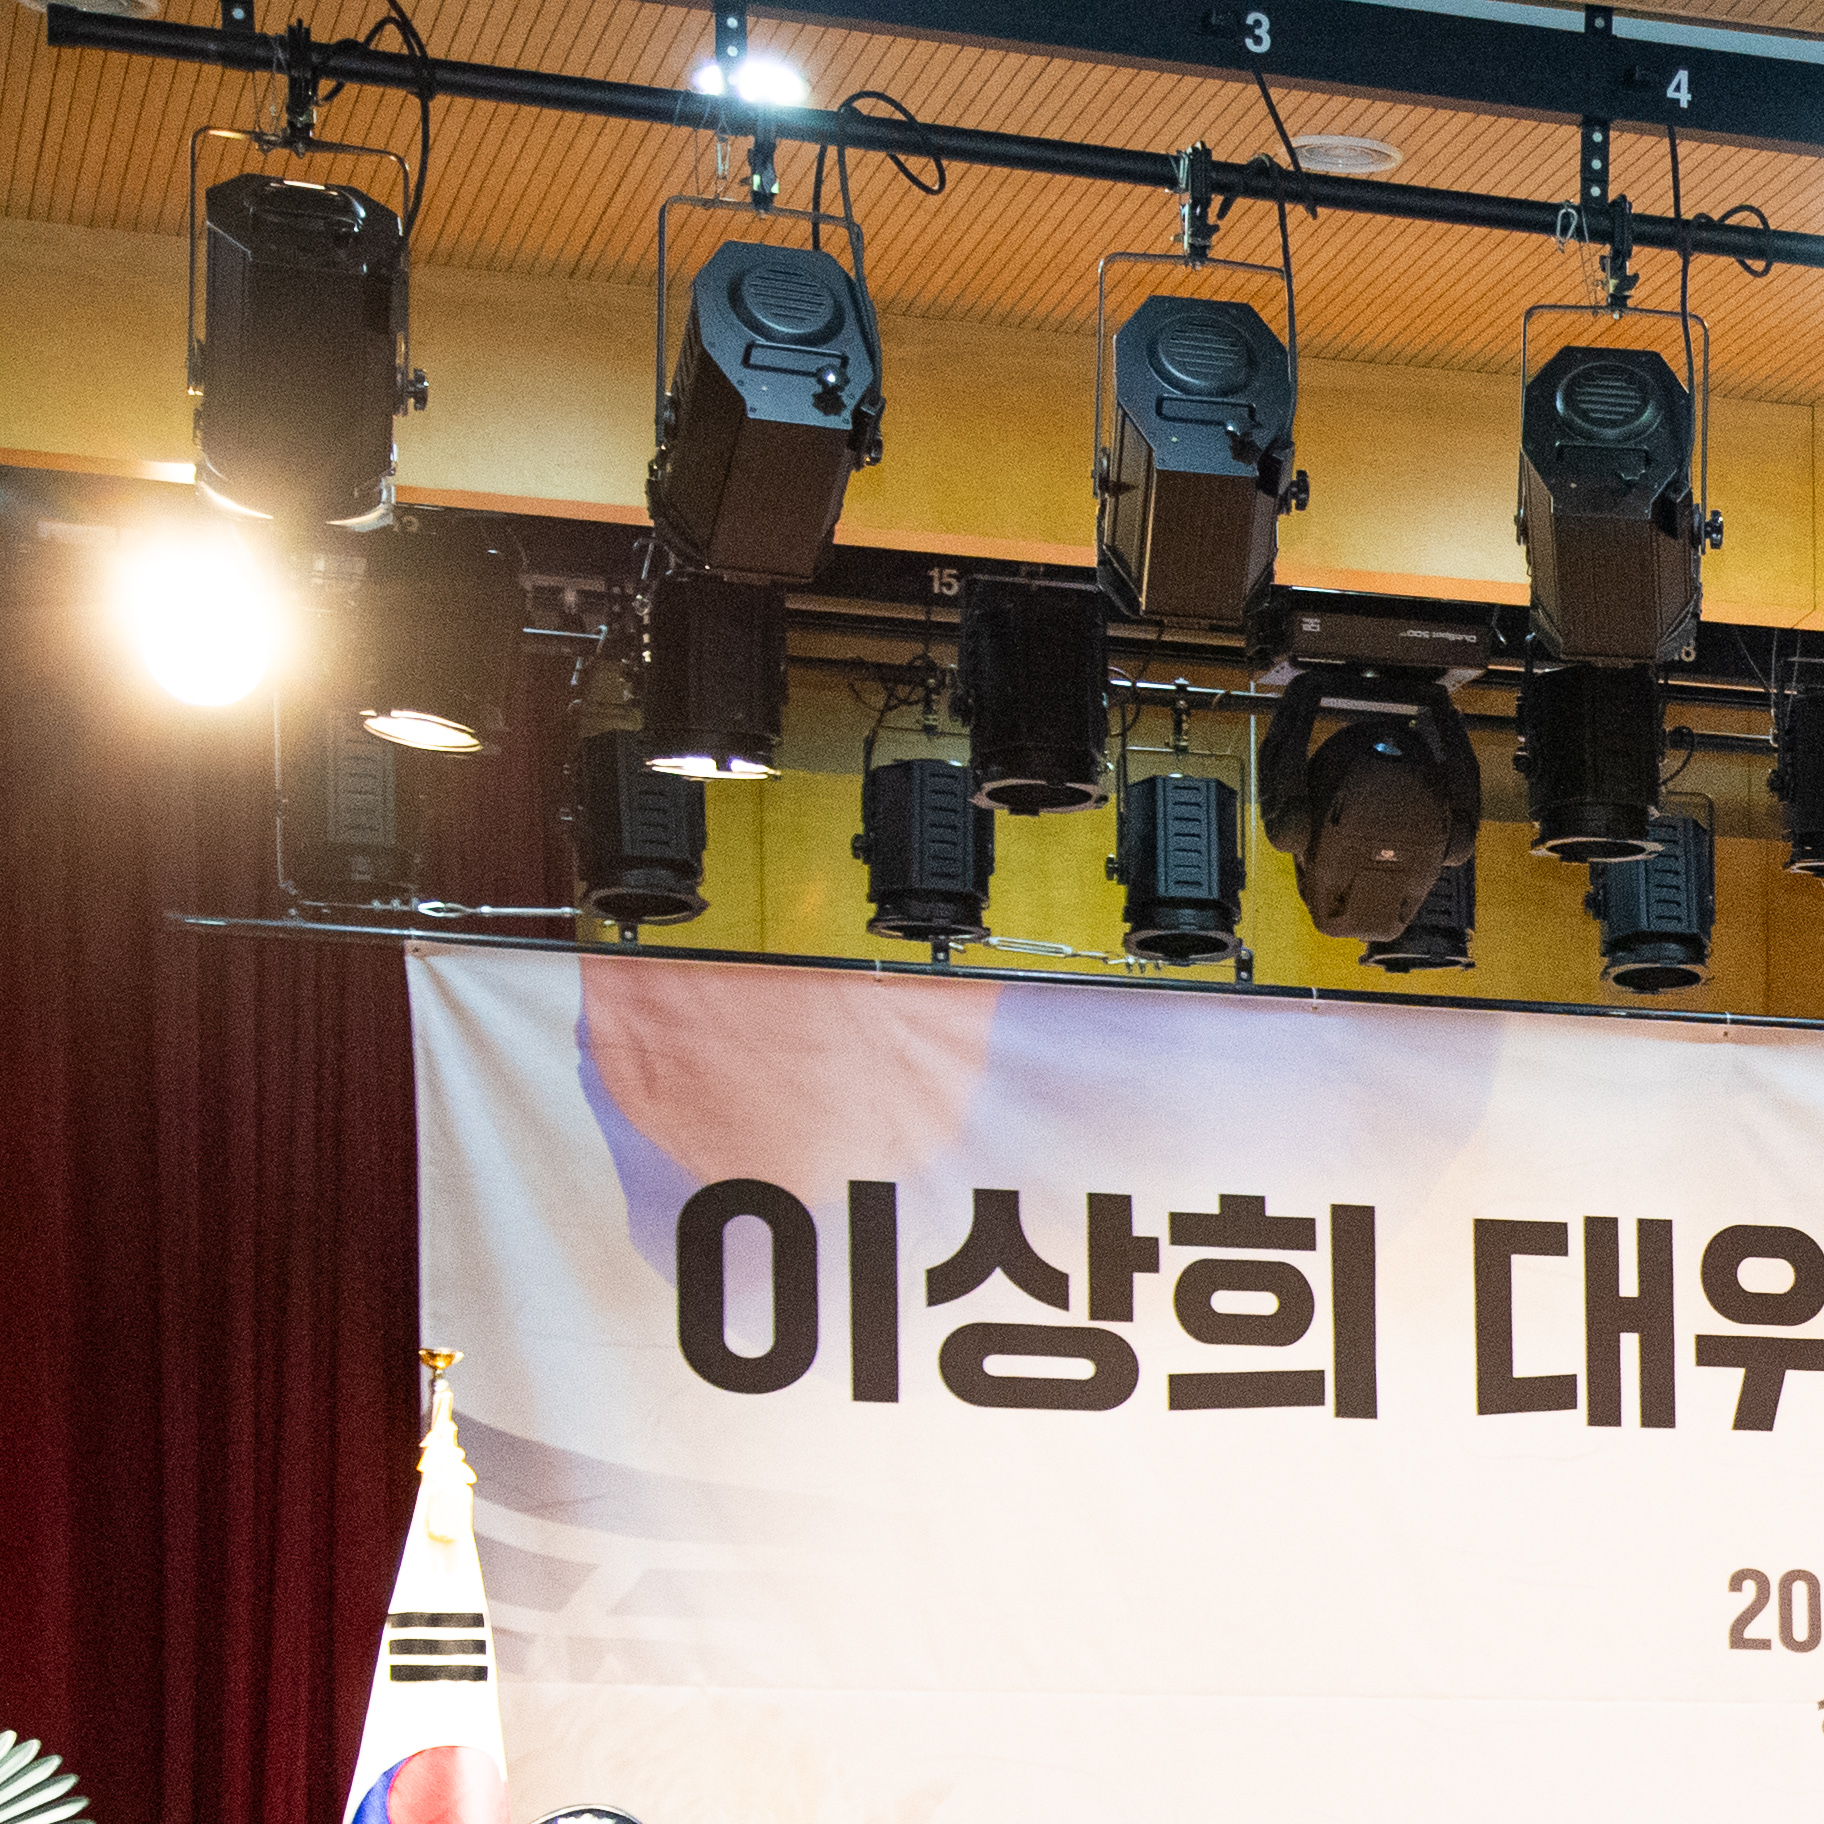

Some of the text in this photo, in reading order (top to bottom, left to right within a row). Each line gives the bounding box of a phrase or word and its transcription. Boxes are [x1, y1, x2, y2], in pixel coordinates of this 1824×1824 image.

[1243, 11, 1273, 54] 3
[1666, 69, 1693, 110] 4
[928, 567, 961, 597] 15
[674, 1177, 1379, 1420] 이상희
